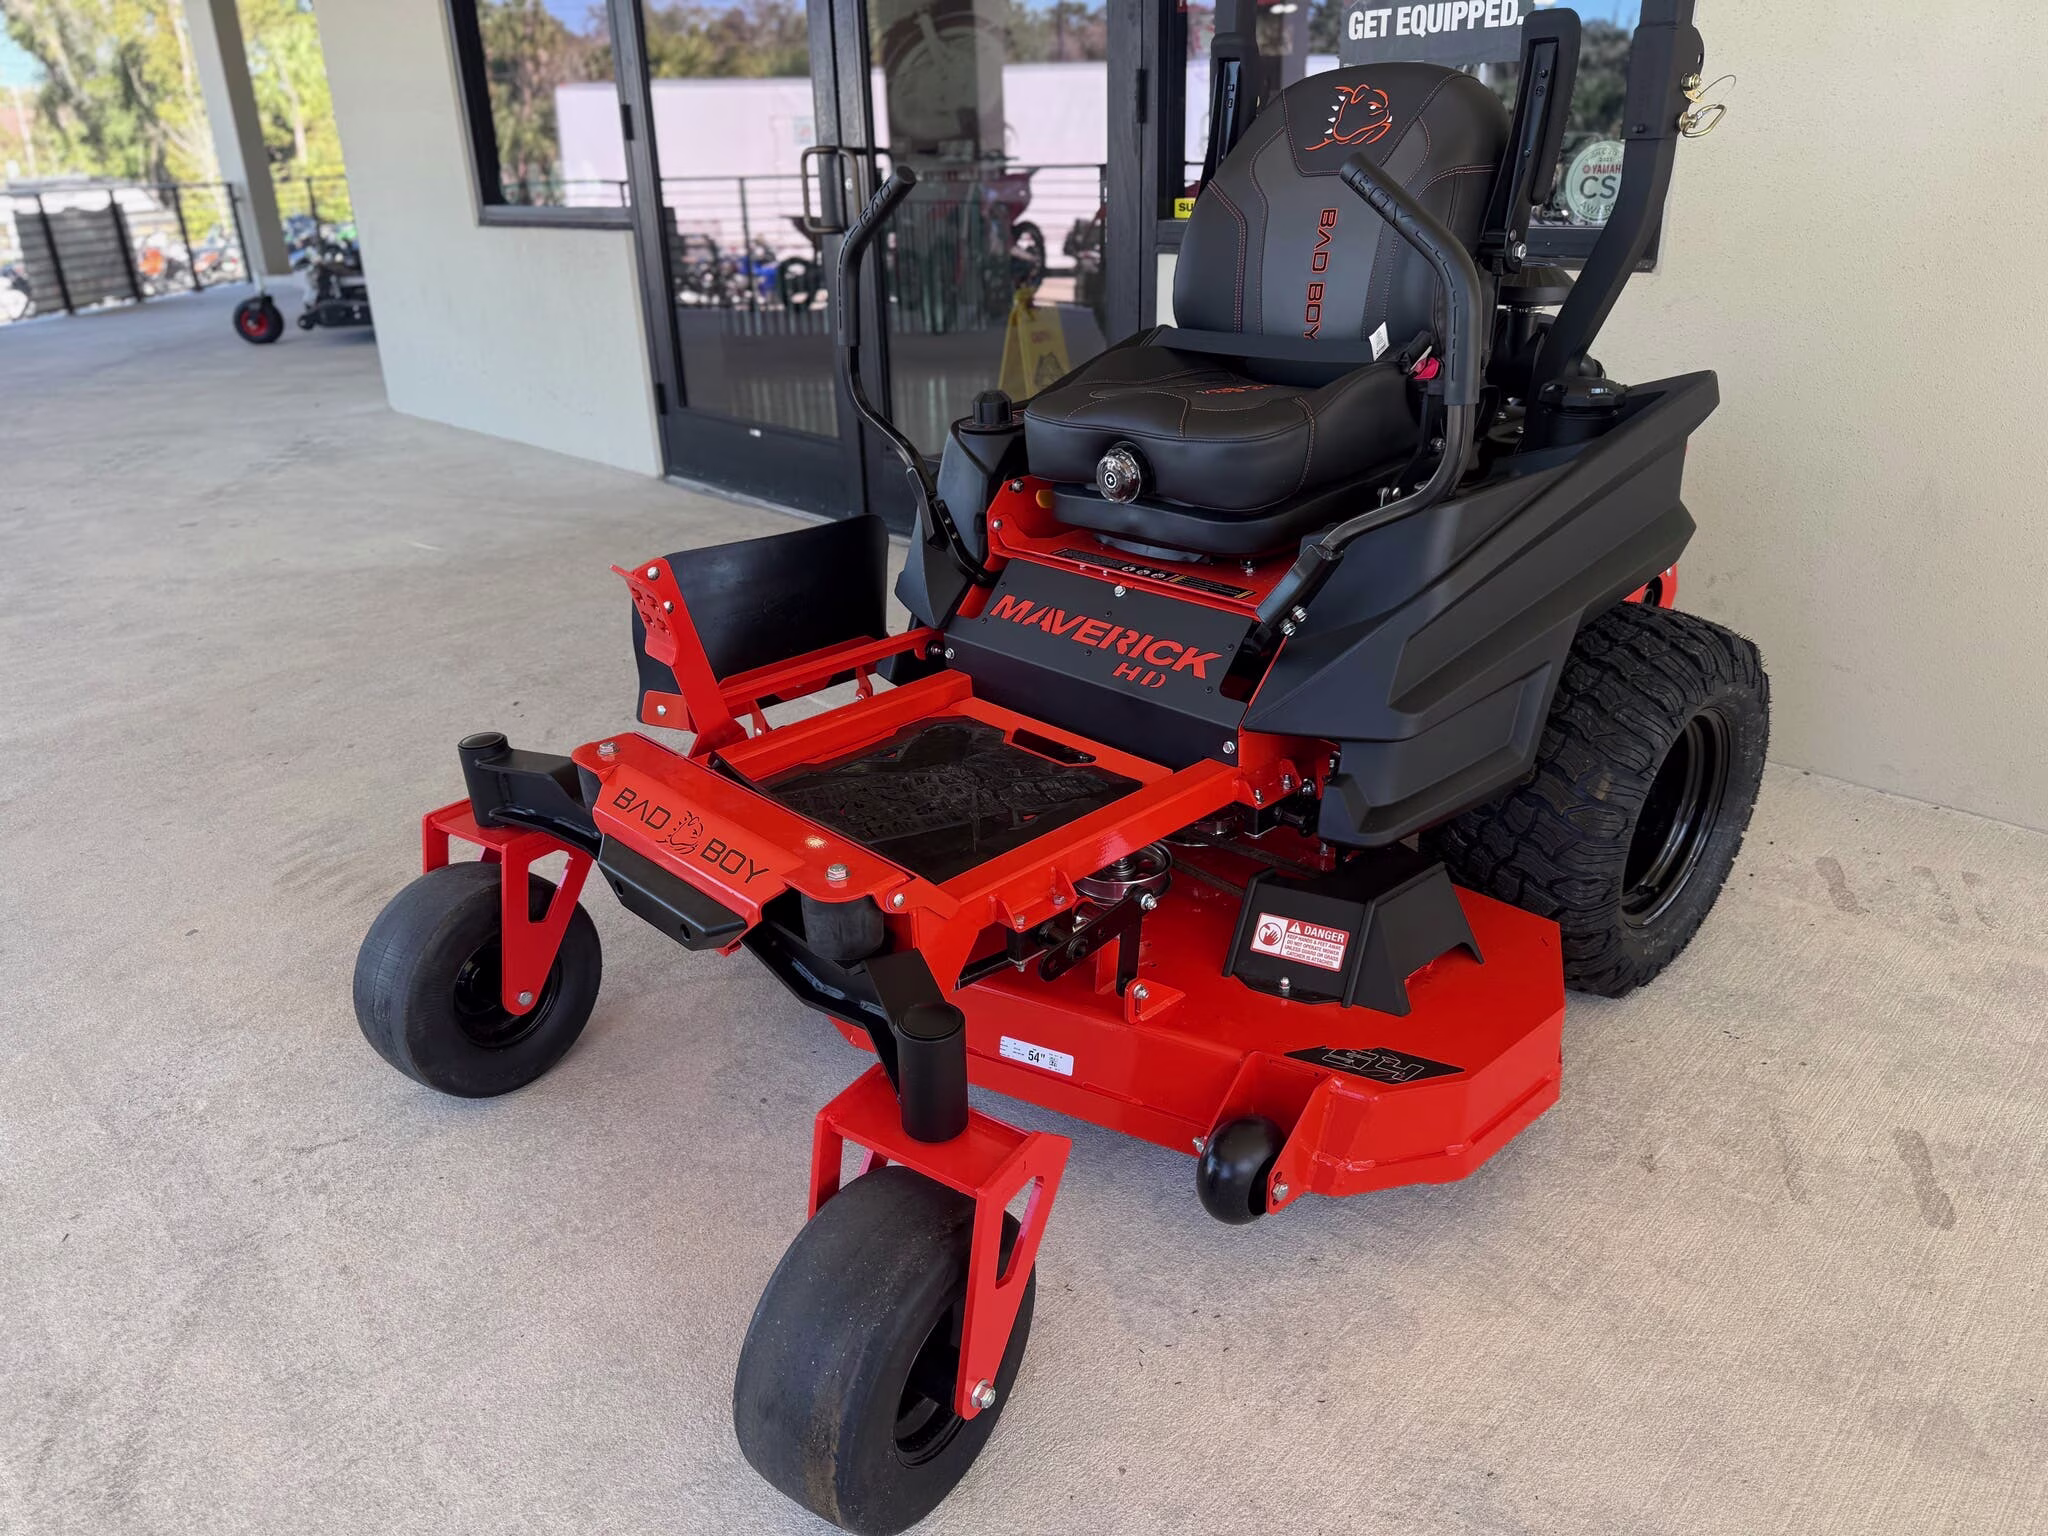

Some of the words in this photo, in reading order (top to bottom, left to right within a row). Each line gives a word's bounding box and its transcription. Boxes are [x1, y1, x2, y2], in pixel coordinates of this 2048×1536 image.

[1348, 8, 1392, 41] GET
[1396, 0, 1525, 38] EQUIPPED.
[1592, 164, 1621, 174] YAMAH
[1311, 208, 1338, 274] BAD
[1303, 281, 1326, 341] BOY
[989, 593, 1223, 680] MAVERICK
[1112, 662, 1168, 689] HD
[612, 786, 672, 830] BAD
[700, 837, 770, 884] BOY
[1303, 943, 1322, 952] OPERATE
[1304, 925, 1345, 943] DANGER
[1027, 1050, 1046, 1063] 54"
